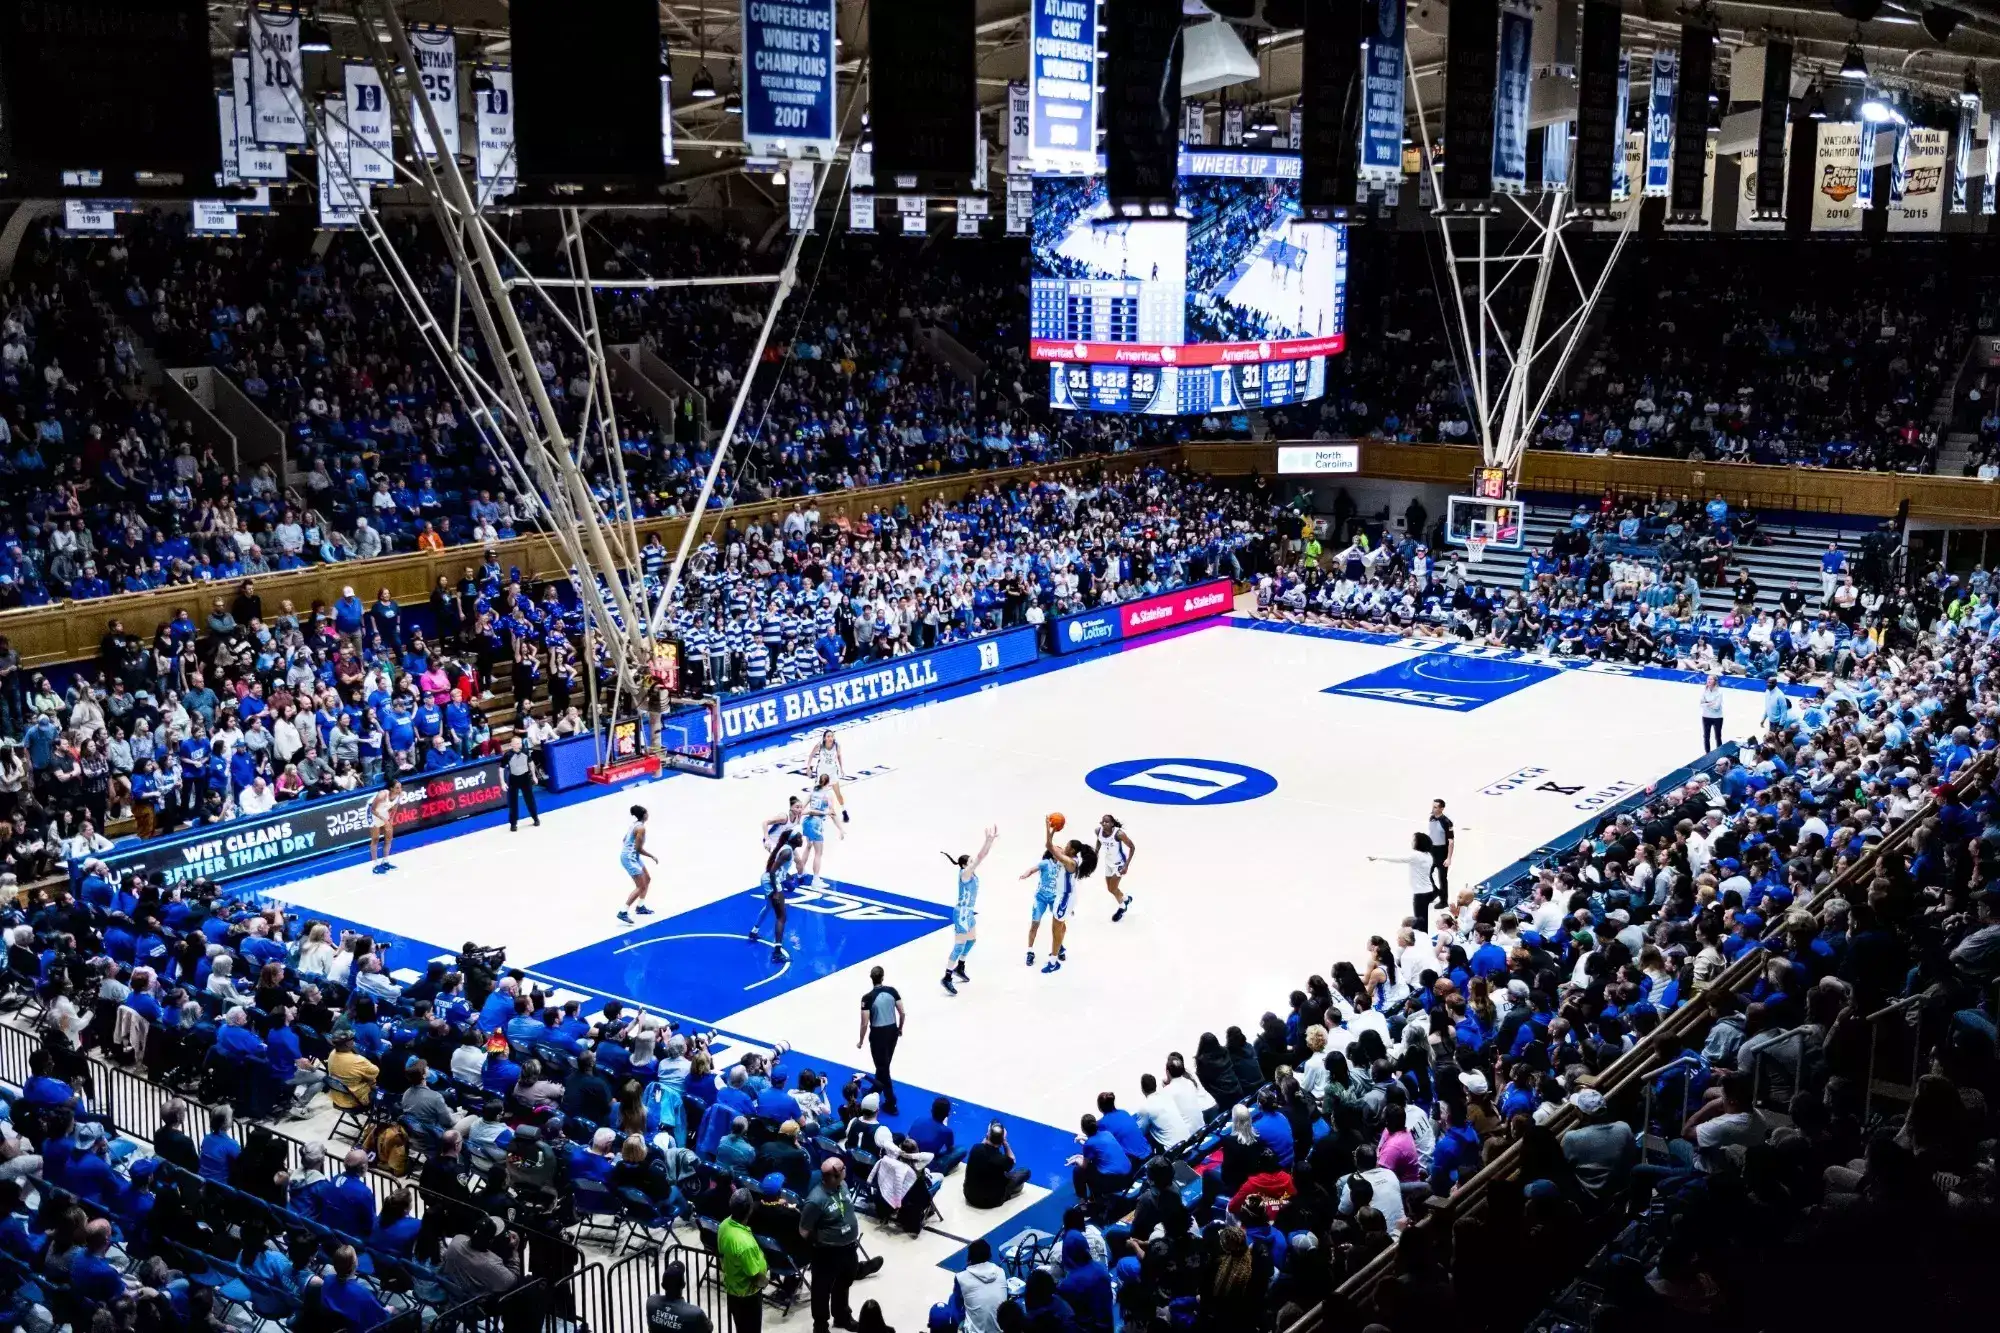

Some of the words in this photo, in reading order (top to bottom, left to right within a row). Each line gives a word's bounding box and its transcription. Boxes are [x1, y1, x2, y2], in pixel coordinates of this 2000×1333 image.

[750, 3, 830, 31] CONFERENCE
[1045, 0, 1087, 21] ATLANTIC
[1051, 19, 1081, 40] COAST
[762, 28, 821, 53] WOMEN'S
[1036, 37, 1093, 63] CONFERENCE
[1374, 45, 1400, 60] ATLANTIC
[420, 51, 453, 69] EYMAN
[755, 50, 827, 77] CHAMPIONS
[1378, 61, 1396, 76] COAST
[265, 58, 292, 88] 10
[1043, 58, 1087, 81] WOMEN'S
[761, 75, 795, 90] REGULAR
[795, 78, 821, 93] SEASON
[1367, 76, 1402, 93] CONFERENCE
[768, 90, 816, 106] TOURNAMENT
[775, 106, 808, 128] 2001
[1367, 108, 1402, 124] CHAMPIONS
[1014, 117, 1028, 136] 35
[1653, 113, 1670, 144] 20
[1824, 136, 1861, 147] NATIONAL
[1819, 147, 1860, 159] CHAMPION
[1192, 156, 1252, 176] WHEELS
[1252, 157, 1268, 174] UP
[82, 215, 101, 224] 1999
[1826, 209, 1850, 219] 2010
[1903, 209, 1928, 220] 2015
[1036, 345, 1076, 359] Ameritas
[1114, 348, 1161, 362] Ameritas
[1221, 349, 1260, 361] Ameritas
[1069, 370, 1089, 389] 31
[1092, 371, 1128, 388] 8:22
[1132, 372, 1154, 392] 32
[1242, 364, 1261, 389] 31
[1267, 363, 1291, 382] 8:22
[1294, 359, 1307, 382] 32
[1316, 451, 1342, 460] North
[1316, 460, 1353, 469] Carolina
[1485, 480, 1502, 498] 18
[1083, 623, 1114, 641] Lottery
[704, 699, 778, 744] DUKE
[783, 659, 938, 722] BASKETBALL
[399, 786, 428, 805] Best
[427, 780, 455, 799] Coke
[454, 771, 488, 791] Ever?
[1484, 767, 1548, 795] COACH
[1534, 781, 1586, 795] K
[420, 798, 456, 818] ZERO
[458, 786, 503, 808] SUGAR
[1574, 780, 1638, 810] COURT
[326, 806, 368, 829] DUDE
[328, 820, 371, 837] WIPES
[183, 840, 223, 863] WET
[226, 823, 293, 852] CLEANS
[162, 856, 228, 886] BETTER
[229, 841, 279, 868] THAN
[282, 832, 317, 854] DRY
[651, 1314, 683, 1330] SERVICES
[656, 1310, 679, 1322] EVENT
